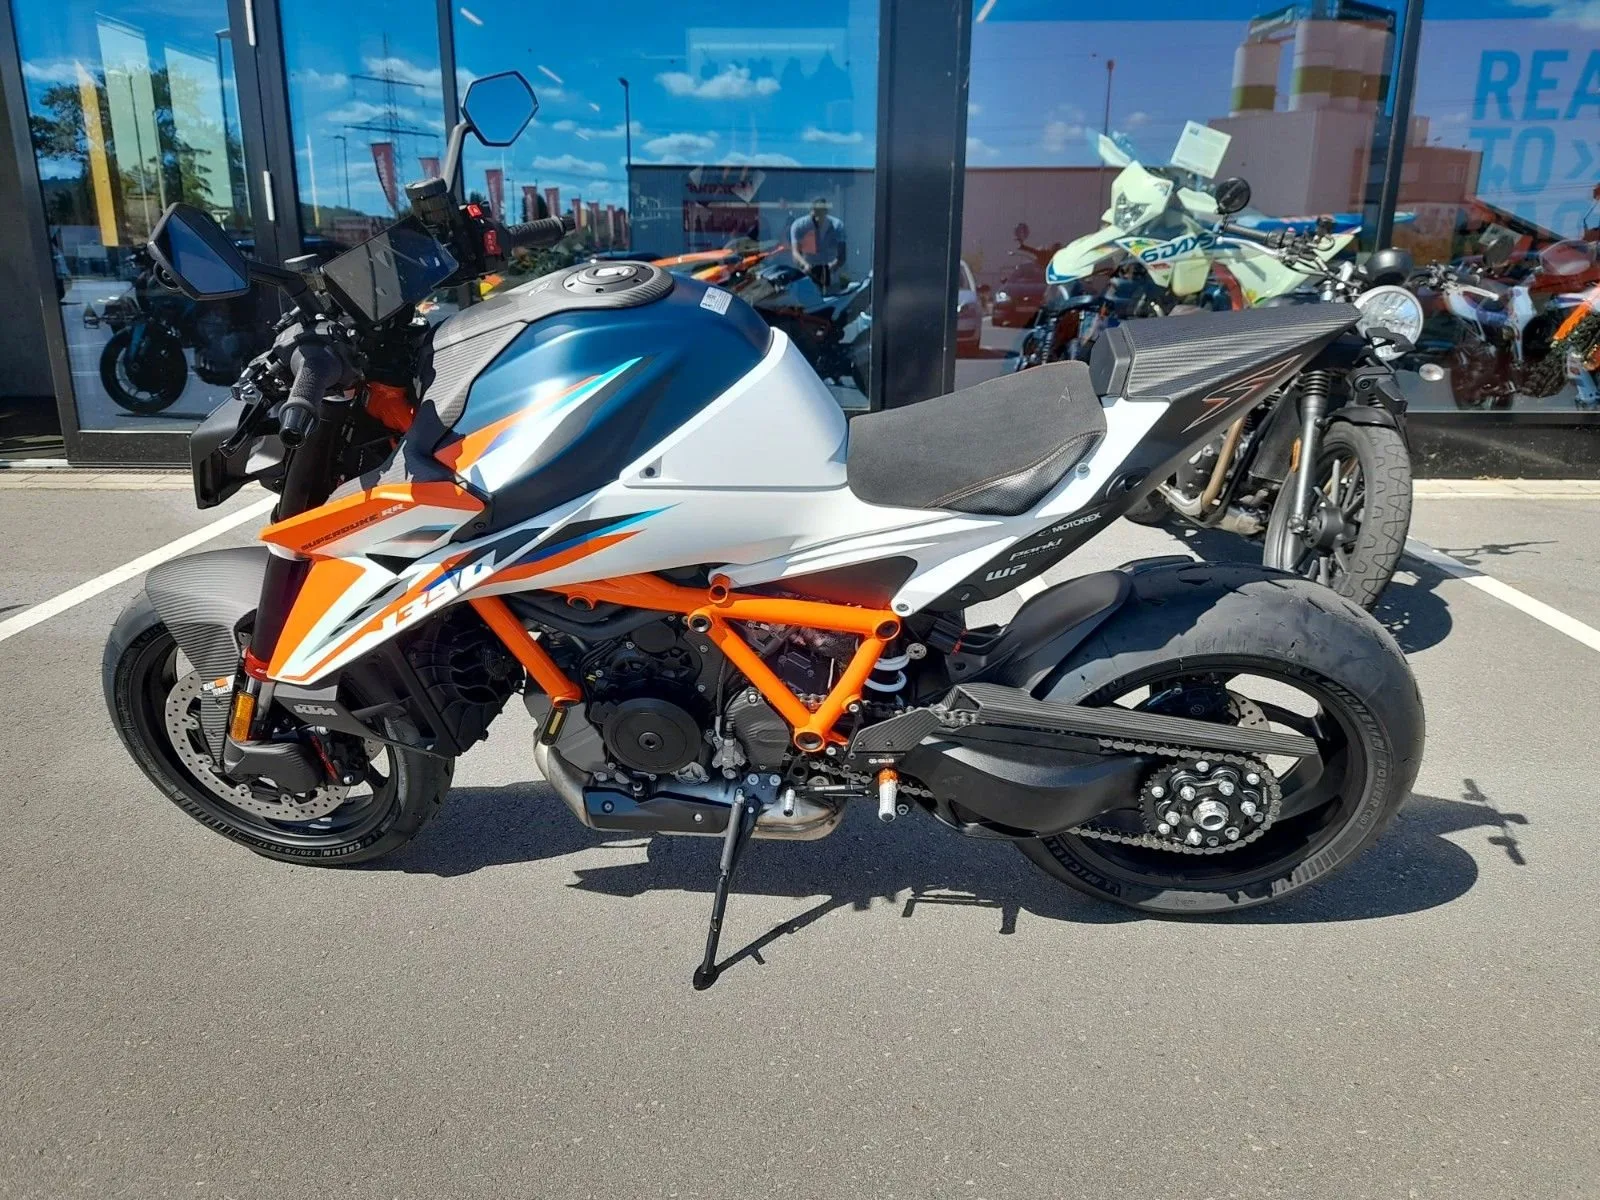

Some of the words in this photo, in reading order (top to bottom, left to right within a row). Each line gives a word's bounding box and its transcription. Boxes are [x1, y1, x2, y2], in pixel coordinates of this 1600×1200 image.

[1469, 126, 1556, 195] TO
[1140, 232, 1215, 263] 6DAYS
[300, 513, 378, 551] SUPERDUKE
[381, 503, 407, 517] RR
[1052, 512, 1102, 533] MOTOREX
[985, 563, 1027, 582] WP
[373, 549, 497, 637] 1350
[293, 703, 338, 716] KTM
